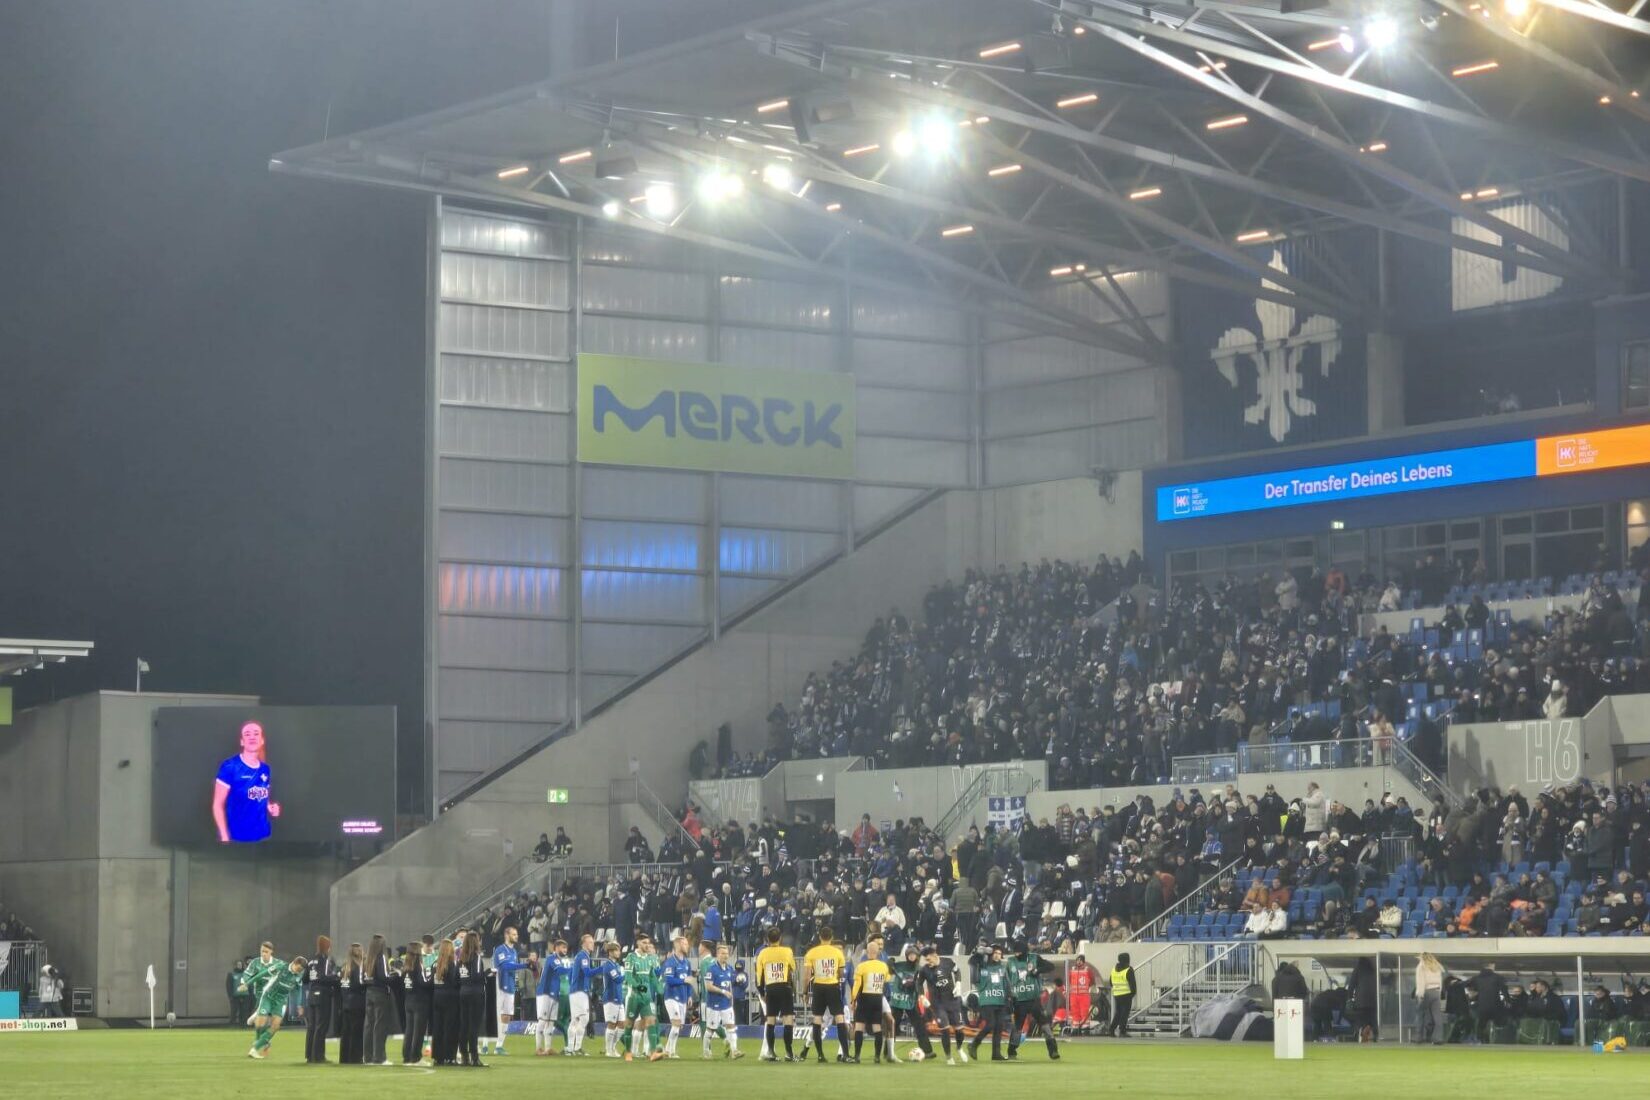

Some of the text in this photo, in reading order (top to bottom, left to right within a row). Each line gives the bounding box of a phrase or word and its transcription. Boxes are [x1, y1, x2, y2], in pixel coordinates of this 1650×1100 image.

[593, 384, 843, 449] MERCK
[1264, 463, 1453, 499] Der Transfer Deines Lebens
[1525, 720, 1580, 783] H6
[985, 989, 1006, 998] HOST
[1013, 984, 1035, 993] HOST
